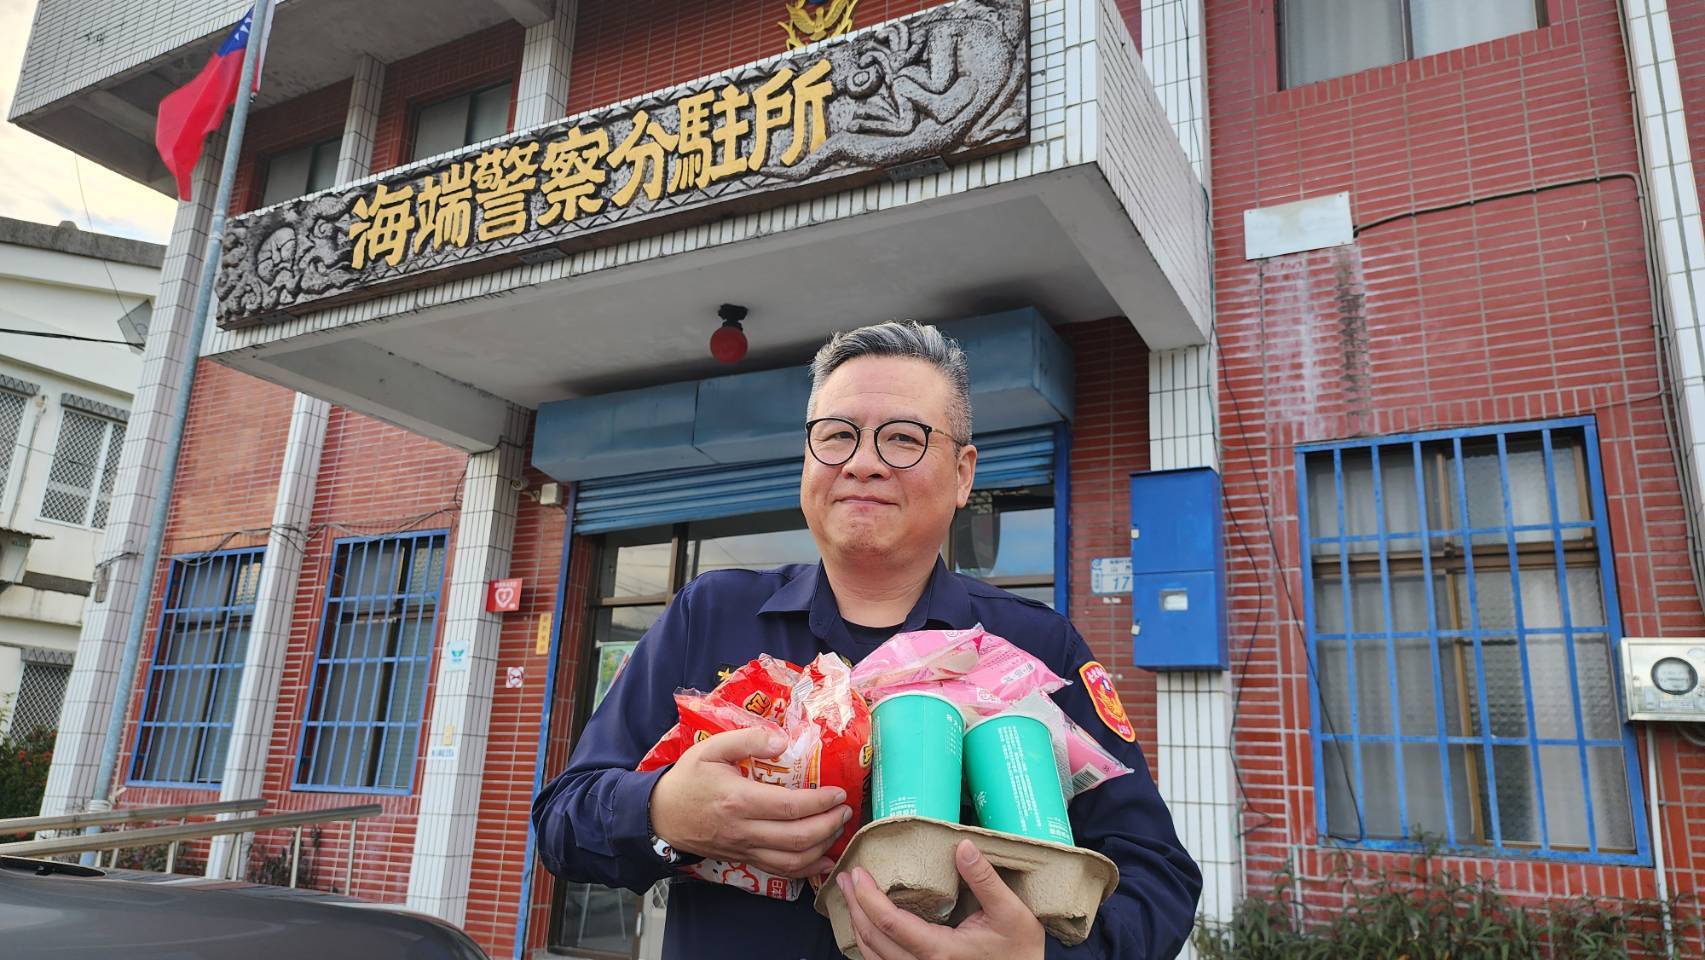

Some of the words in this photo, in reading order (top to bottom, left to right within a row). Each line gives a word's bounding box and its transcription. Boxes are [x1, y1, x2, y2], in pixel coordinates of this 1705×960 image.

[349, 59, 834, 270] 海端警察分駐所
